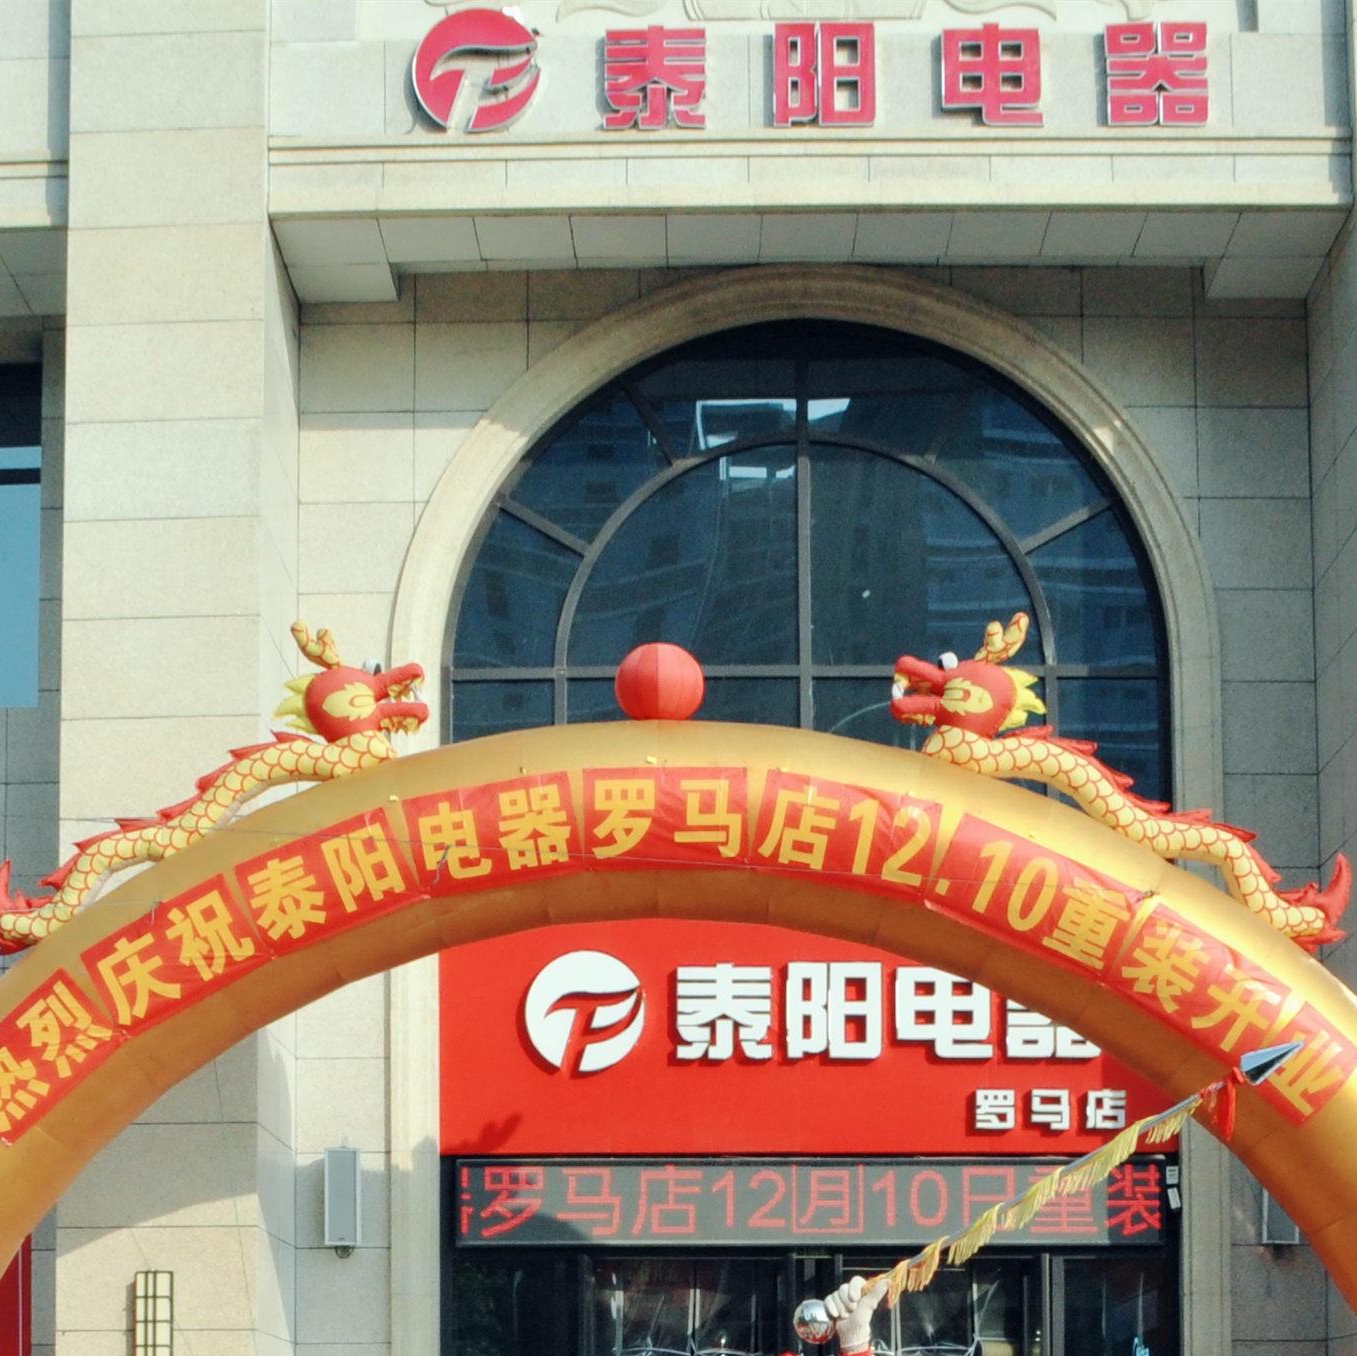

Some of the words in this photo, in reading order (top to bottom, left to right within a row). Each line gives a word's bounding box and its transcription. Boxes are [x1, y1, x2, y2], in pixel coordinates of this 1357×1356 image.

[602, 23, 1211, 131] 泰阳电器
[975, 1088, 1127, 1130] 罗马店
[461, 1164, 1162, 1238] 罗马店12月10日重装
